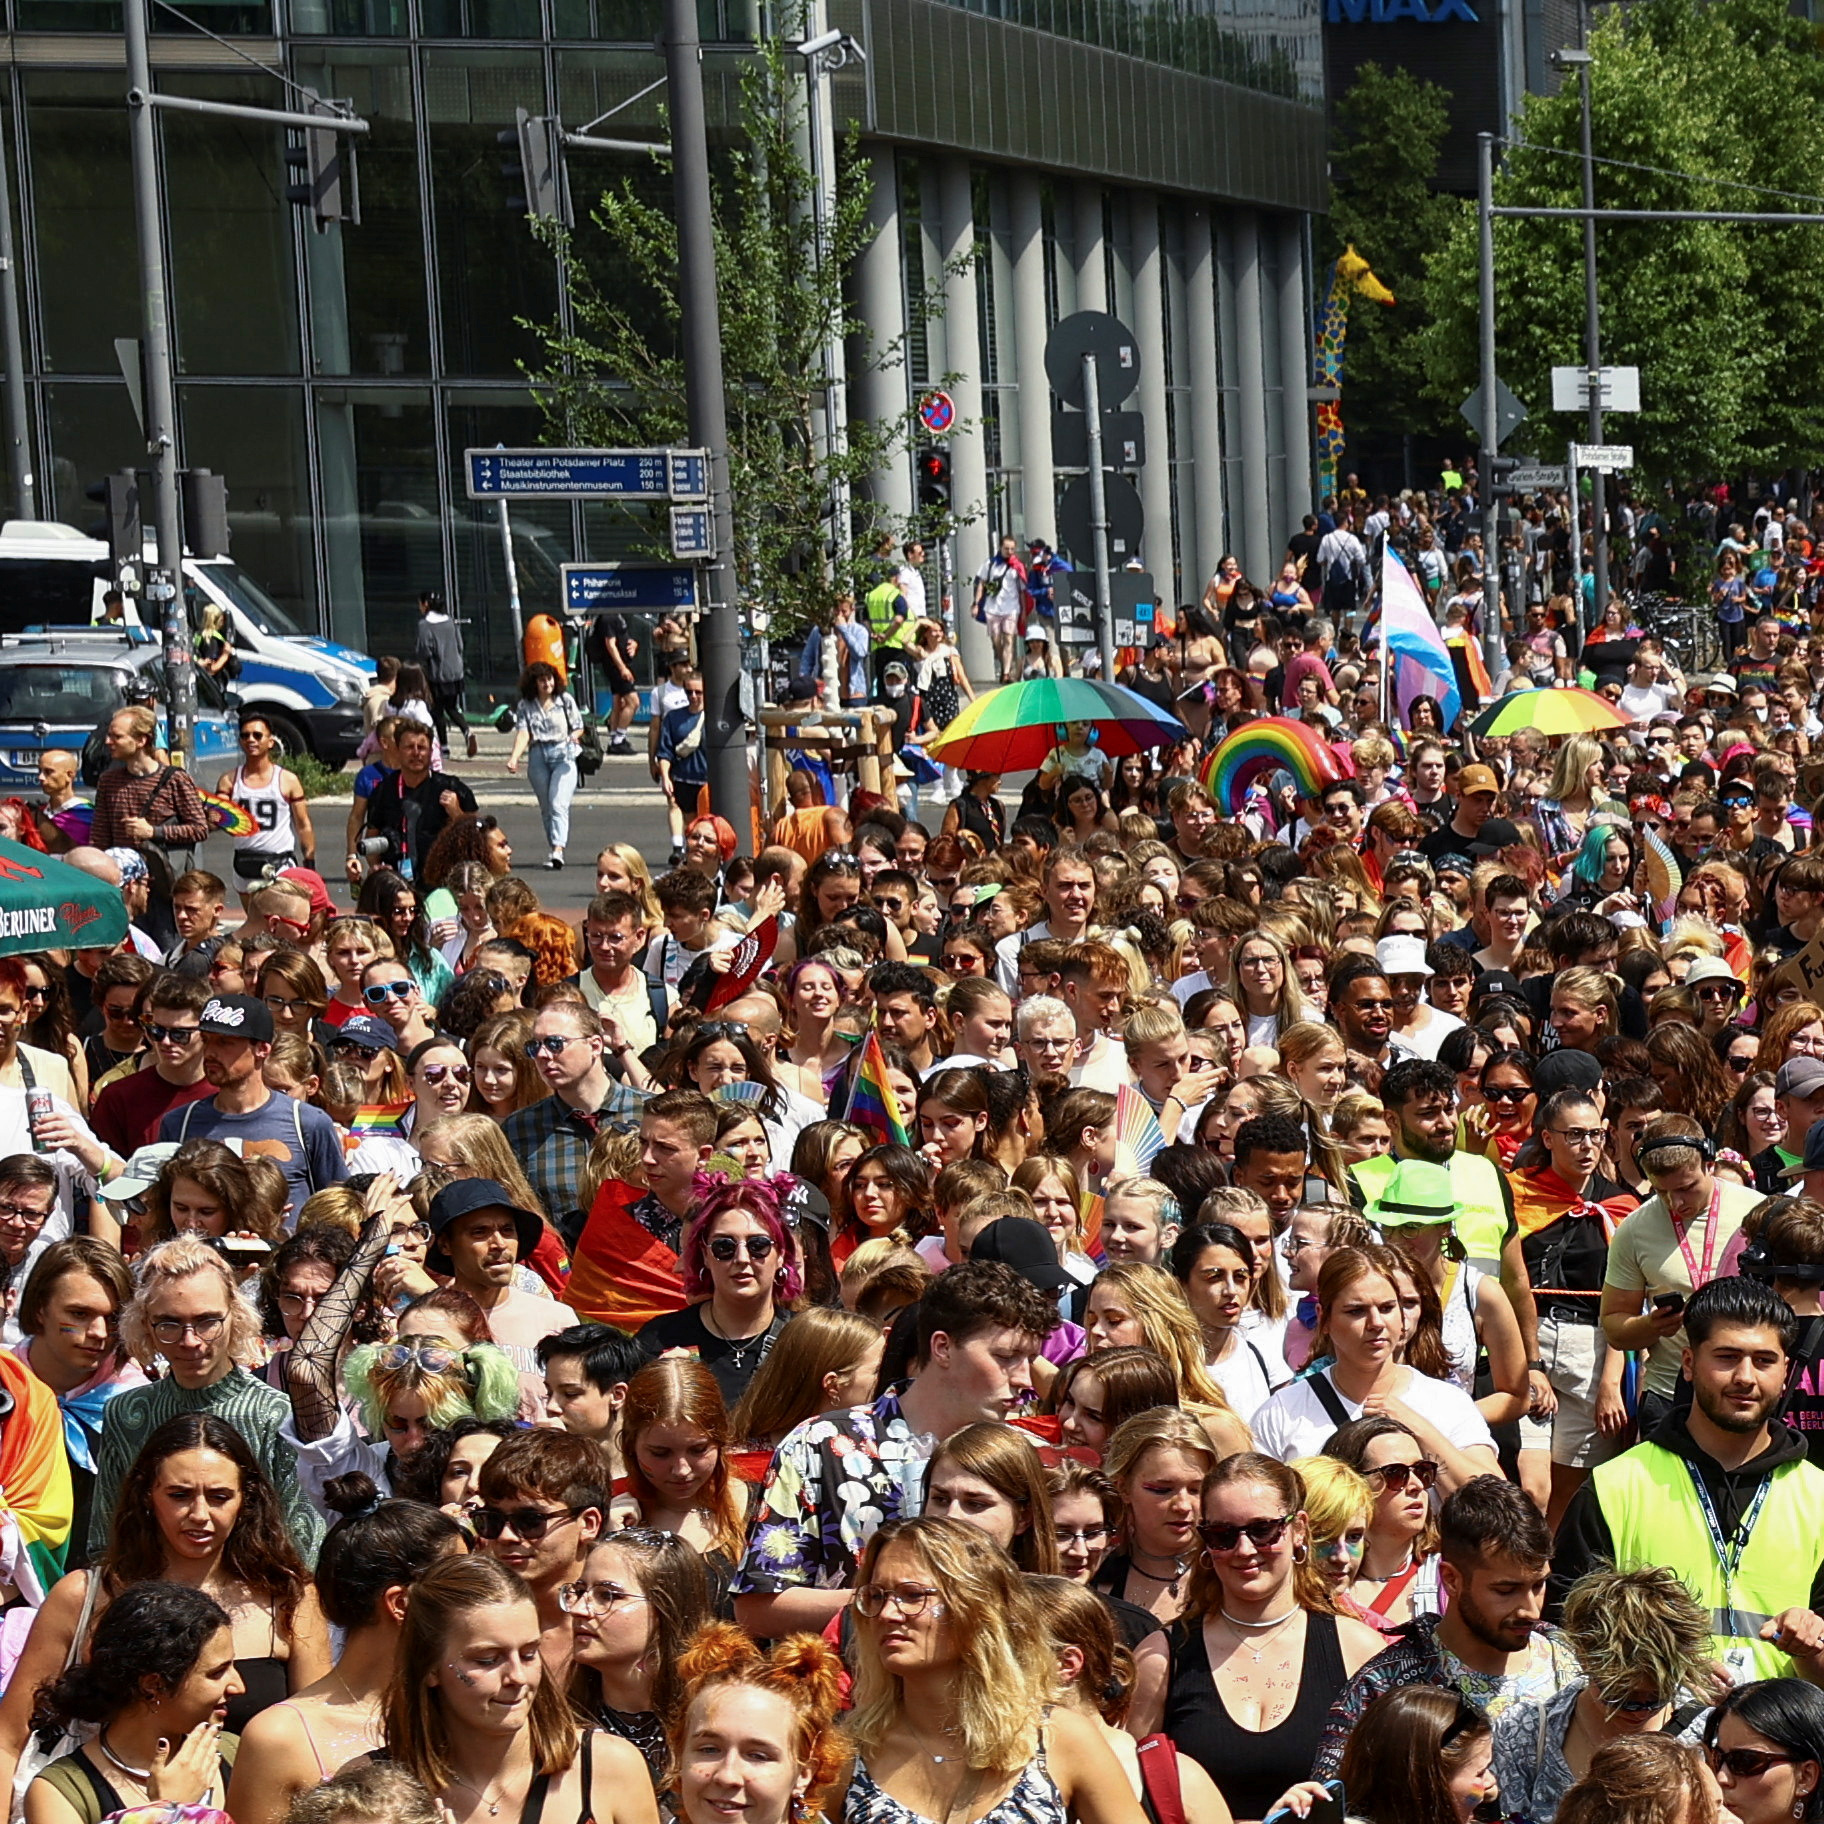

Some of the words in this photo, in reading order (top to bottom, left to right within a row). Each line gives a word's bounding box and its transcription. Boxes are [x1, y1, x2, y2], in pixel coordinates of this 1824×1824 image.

[499, 458, 534, 467] Theater
[552, 458, 601, 467] Potsdamer
[603, 458, 626, 467] Platz
[639, 458, 653, 467] 250
[499, 469, 571, 479] Staatsbibliothek
[639, 469, 653, 478] 200
[500, 481, 623, 490] Musikinstrumentenmuseum
[641, 481, 654, 490] 150
